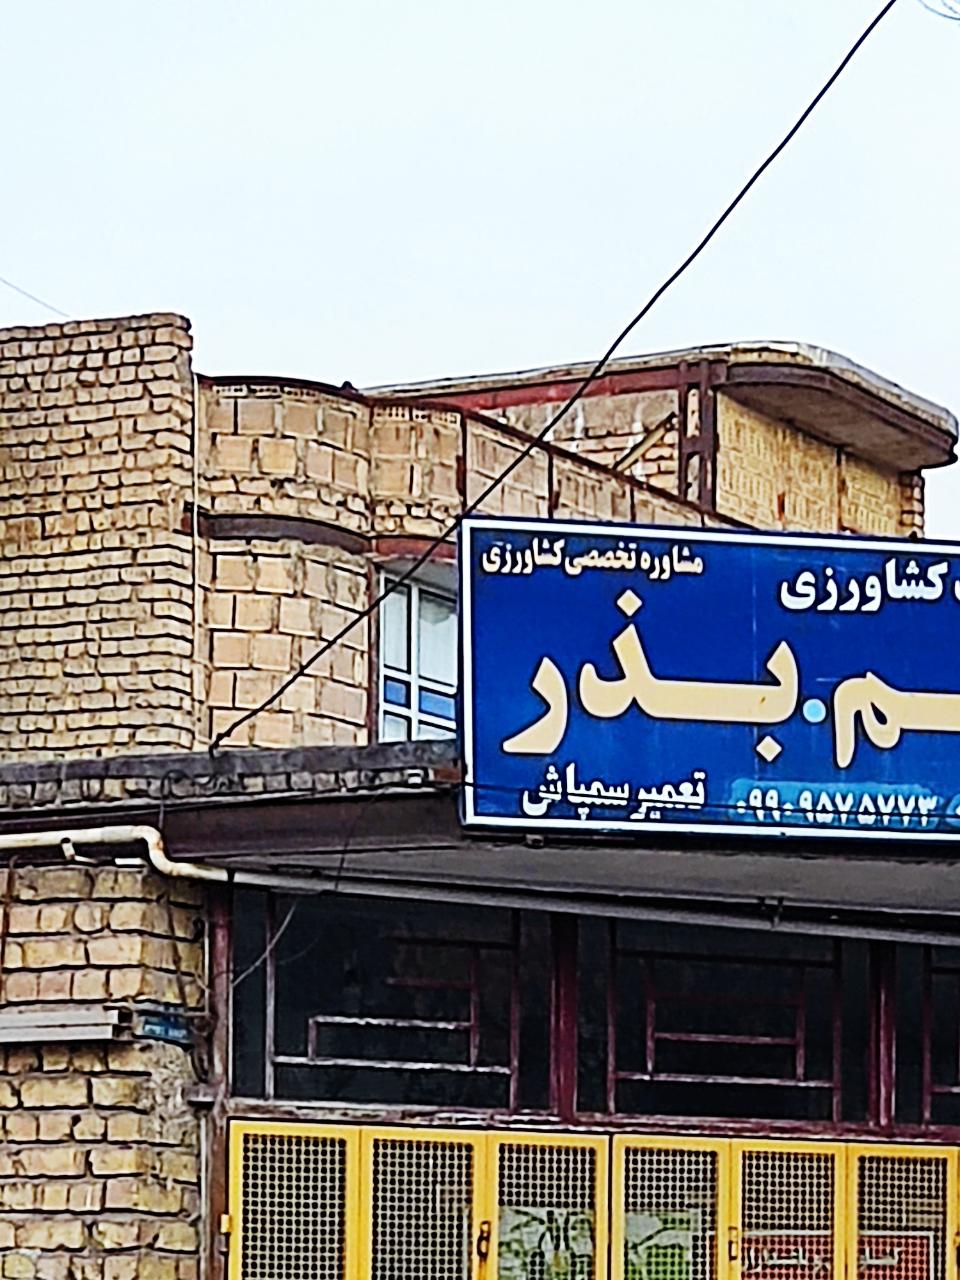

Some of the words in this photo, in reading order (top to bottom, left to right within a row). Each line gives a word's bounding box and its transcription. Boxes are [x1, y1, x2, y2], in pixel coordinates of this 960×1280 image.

[481, 538, 564, 574] کشاورزی
[565, 541, 637, 575] تخصصی
[640, 545, 704, 579] مشاوره
[780, 558, 948, 612] کشاورزی
[502, 589, 798, 762] بذر
[522, 763, 629, 821] سمپاش
[630, 771, 706, 820] تعمیر
